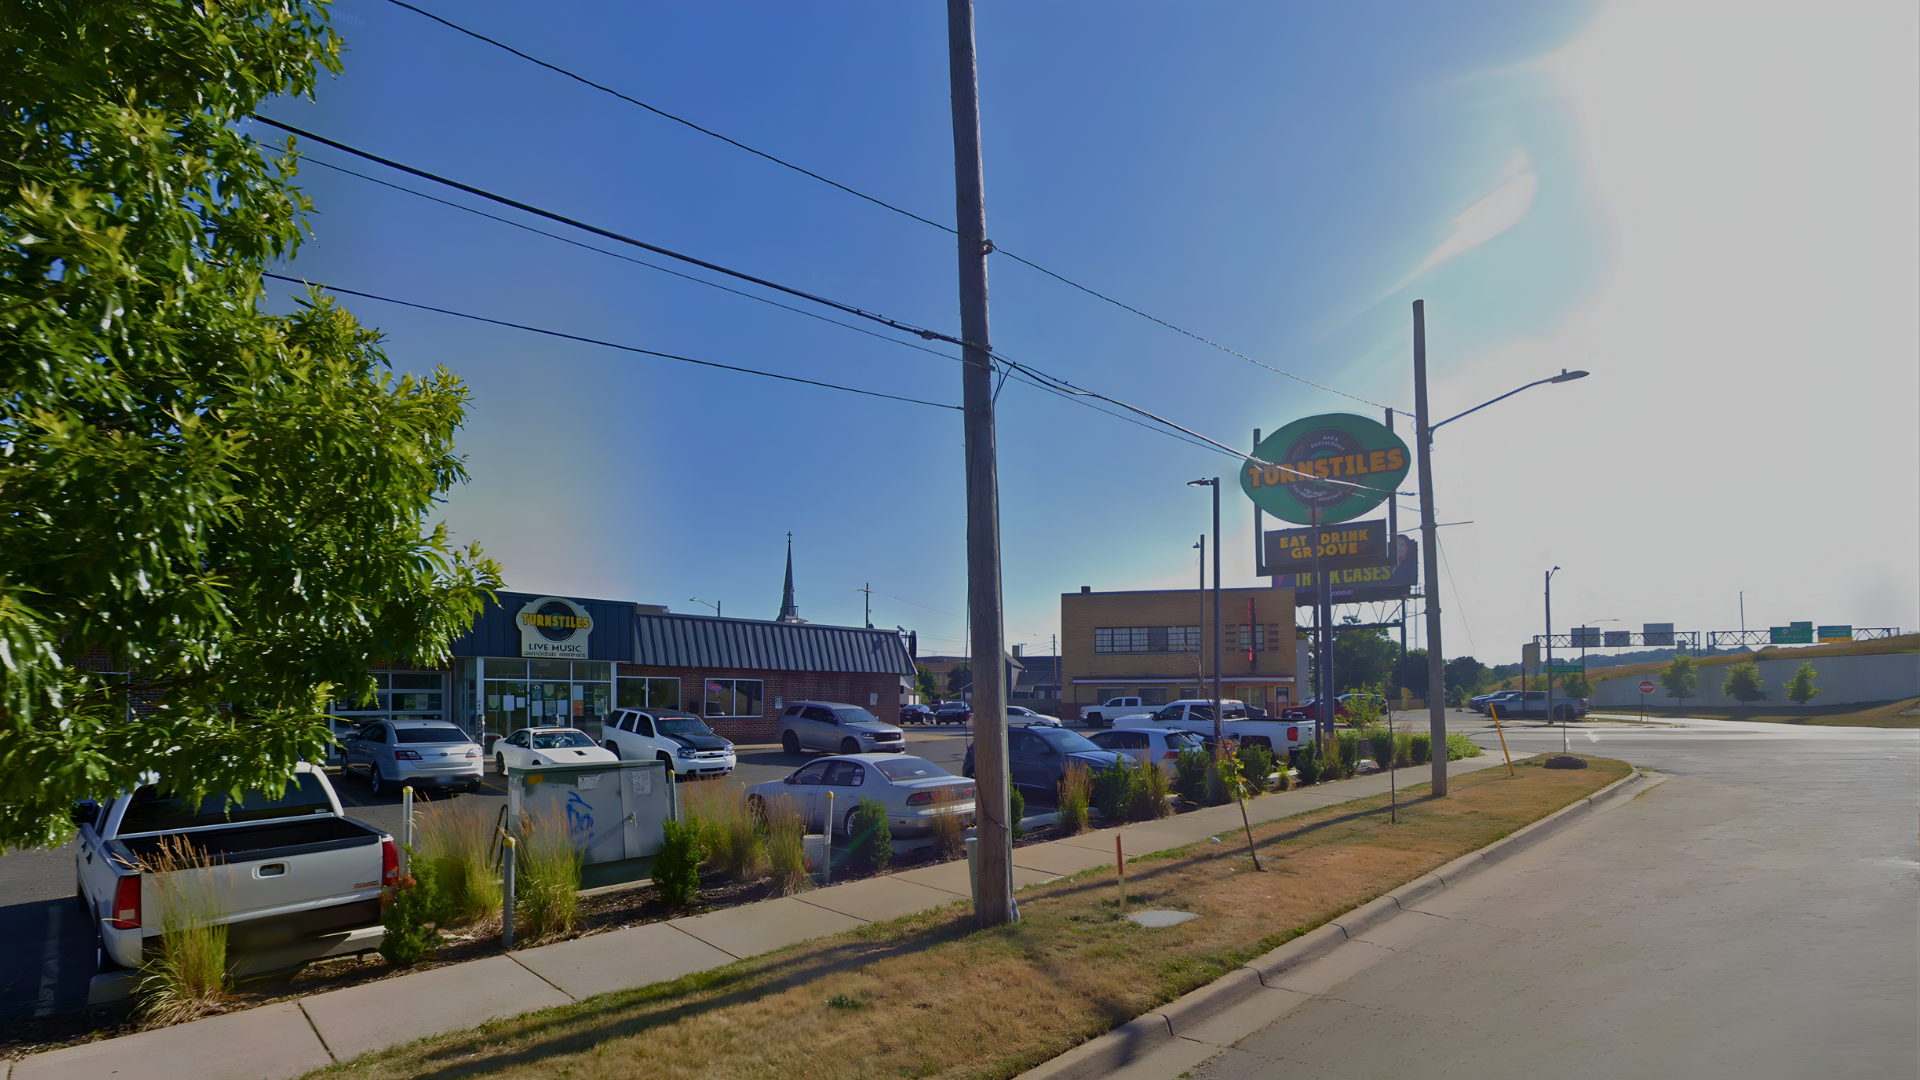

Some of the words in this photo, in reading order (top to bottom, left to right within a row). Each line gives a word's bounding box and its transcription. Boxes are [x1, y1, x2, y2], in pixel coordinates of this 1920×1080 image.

[1310, 440, 1346, 451] RESTAURANT
[1248, 448, 1404, 487] TURNSTILES
[1280, 535, 1307, 549] EAT
[1320, 529, 1369, 545] DRINK
[1295, 570, 1341, 587] TRK
[1343, 566, 1392, 583] CASES
[521, 612, 591, 629] TURNSTILES
[528, 643, 549, 651] LIVE
[551, 644, 582, 652] MUSIC
